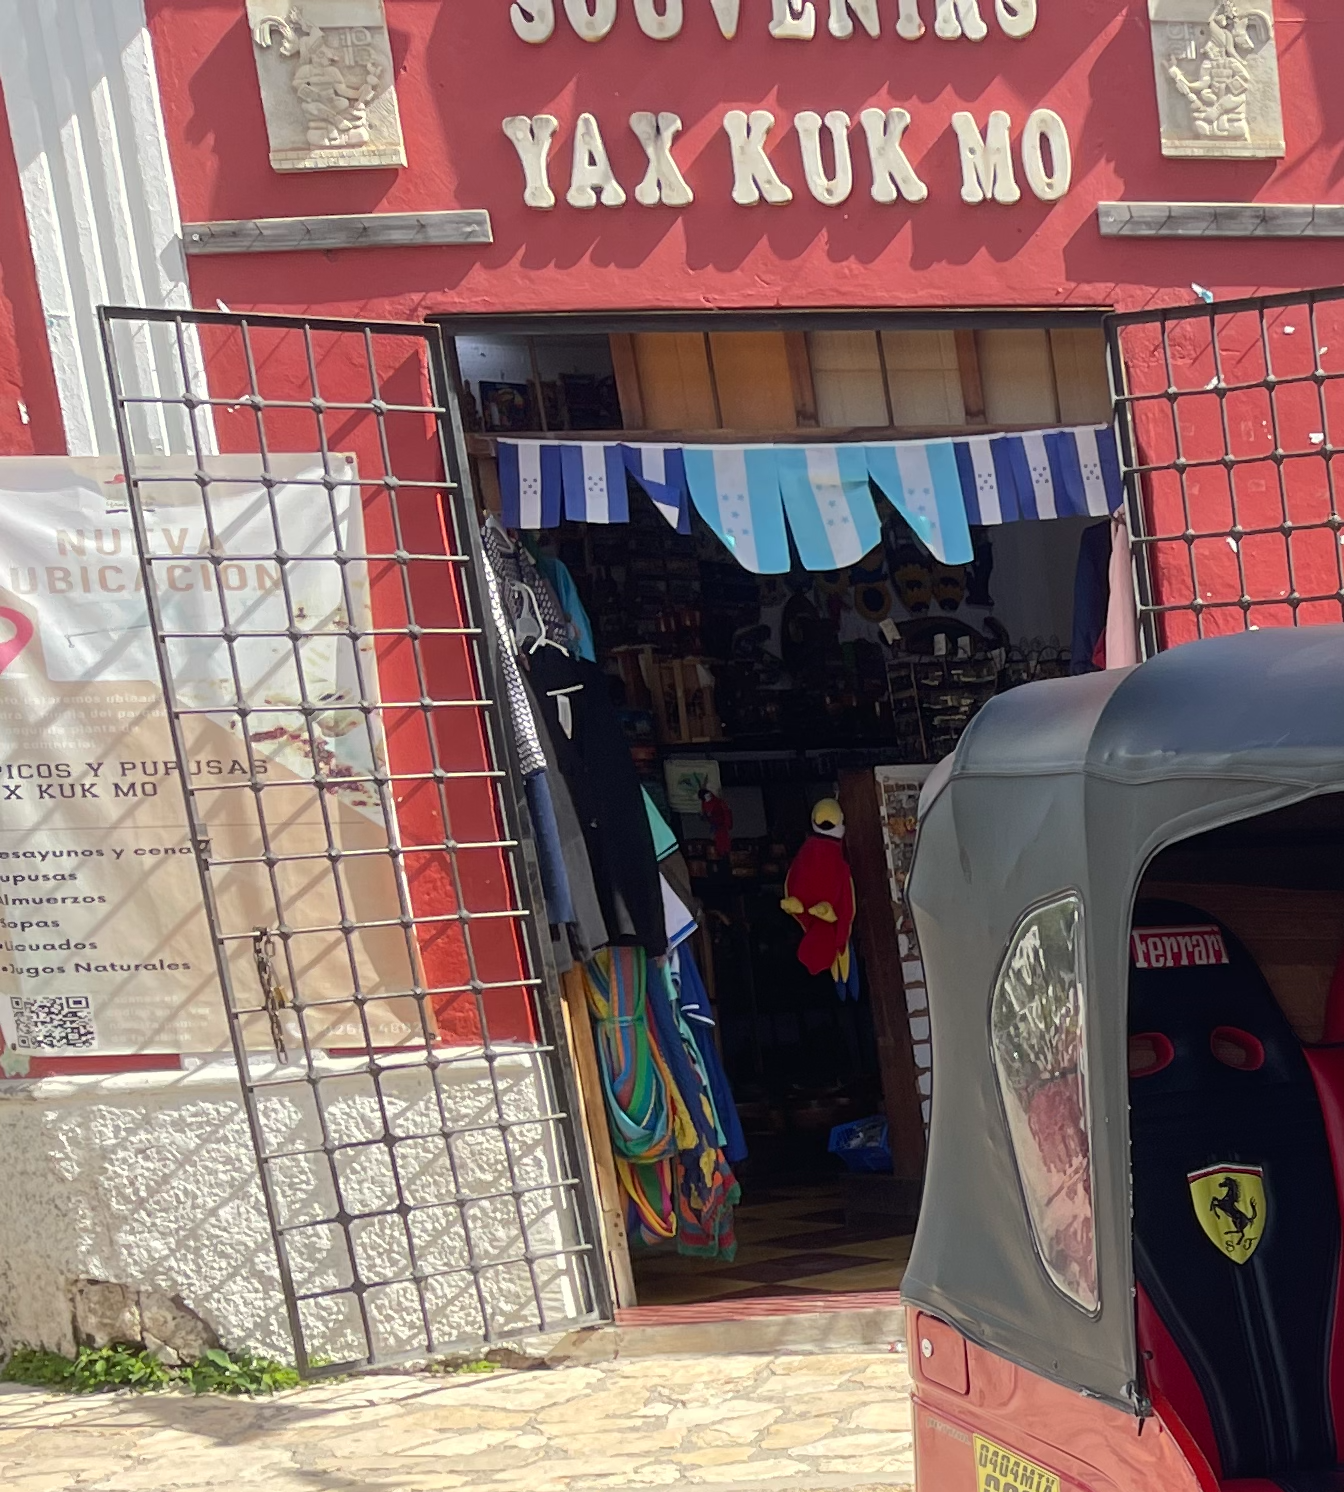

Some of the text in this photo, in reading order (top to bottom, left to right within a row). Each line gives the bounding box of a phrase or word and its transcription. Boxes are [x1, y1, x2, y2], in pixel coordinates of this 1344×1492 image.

[502, 107, 1072, 209] YAX KUK MO
[85, 762, 104, 778] Y
[36, 783, 100, 800] KUK
[112, 781, 158, 798] MO
[1132, 926, 1229, 968] Ferrari
[74, 959, 191, 974] Naturales
